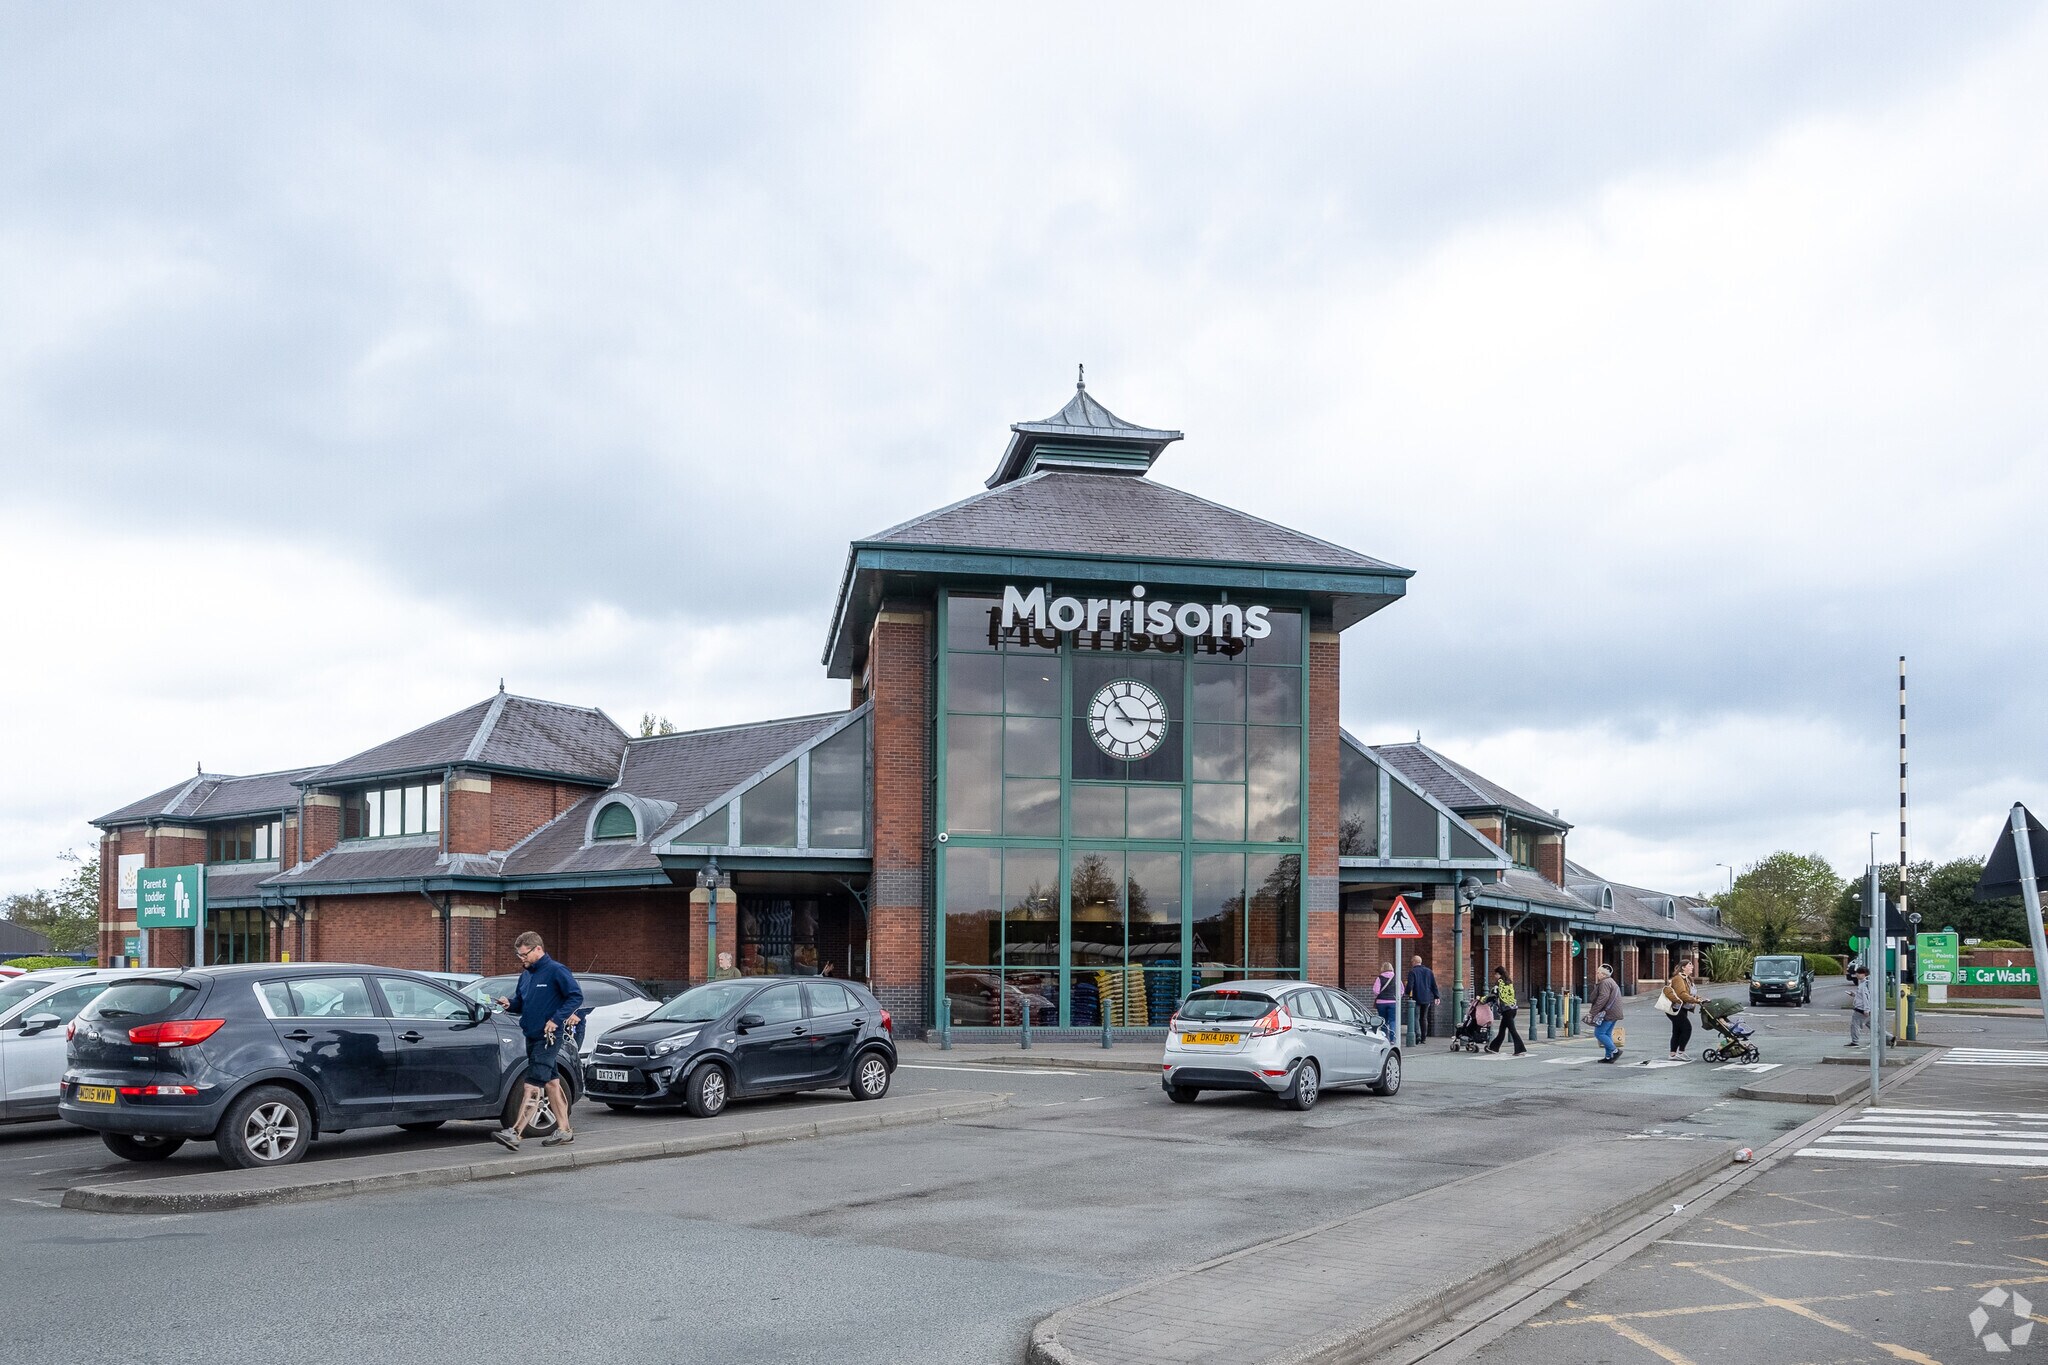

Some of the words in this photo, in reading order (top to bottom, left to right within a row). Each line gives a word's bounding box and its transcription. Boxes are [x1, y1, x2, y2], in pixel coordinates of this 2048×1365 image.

[1001, 584, 1272, 639] Morrisons
[143, 879, 161, 889] Parent
[162, 879, 167, 888] &
[145, 891, 166, 902] toddler
[144, 904, 166, 917] parking
[1975, 969, 1994, 982] Car
[1996, 969, 2031, 982] Wash
[1200, 1033, 1218, 1041] DK14
[1219, 1033, 1235, 1042] UBX
